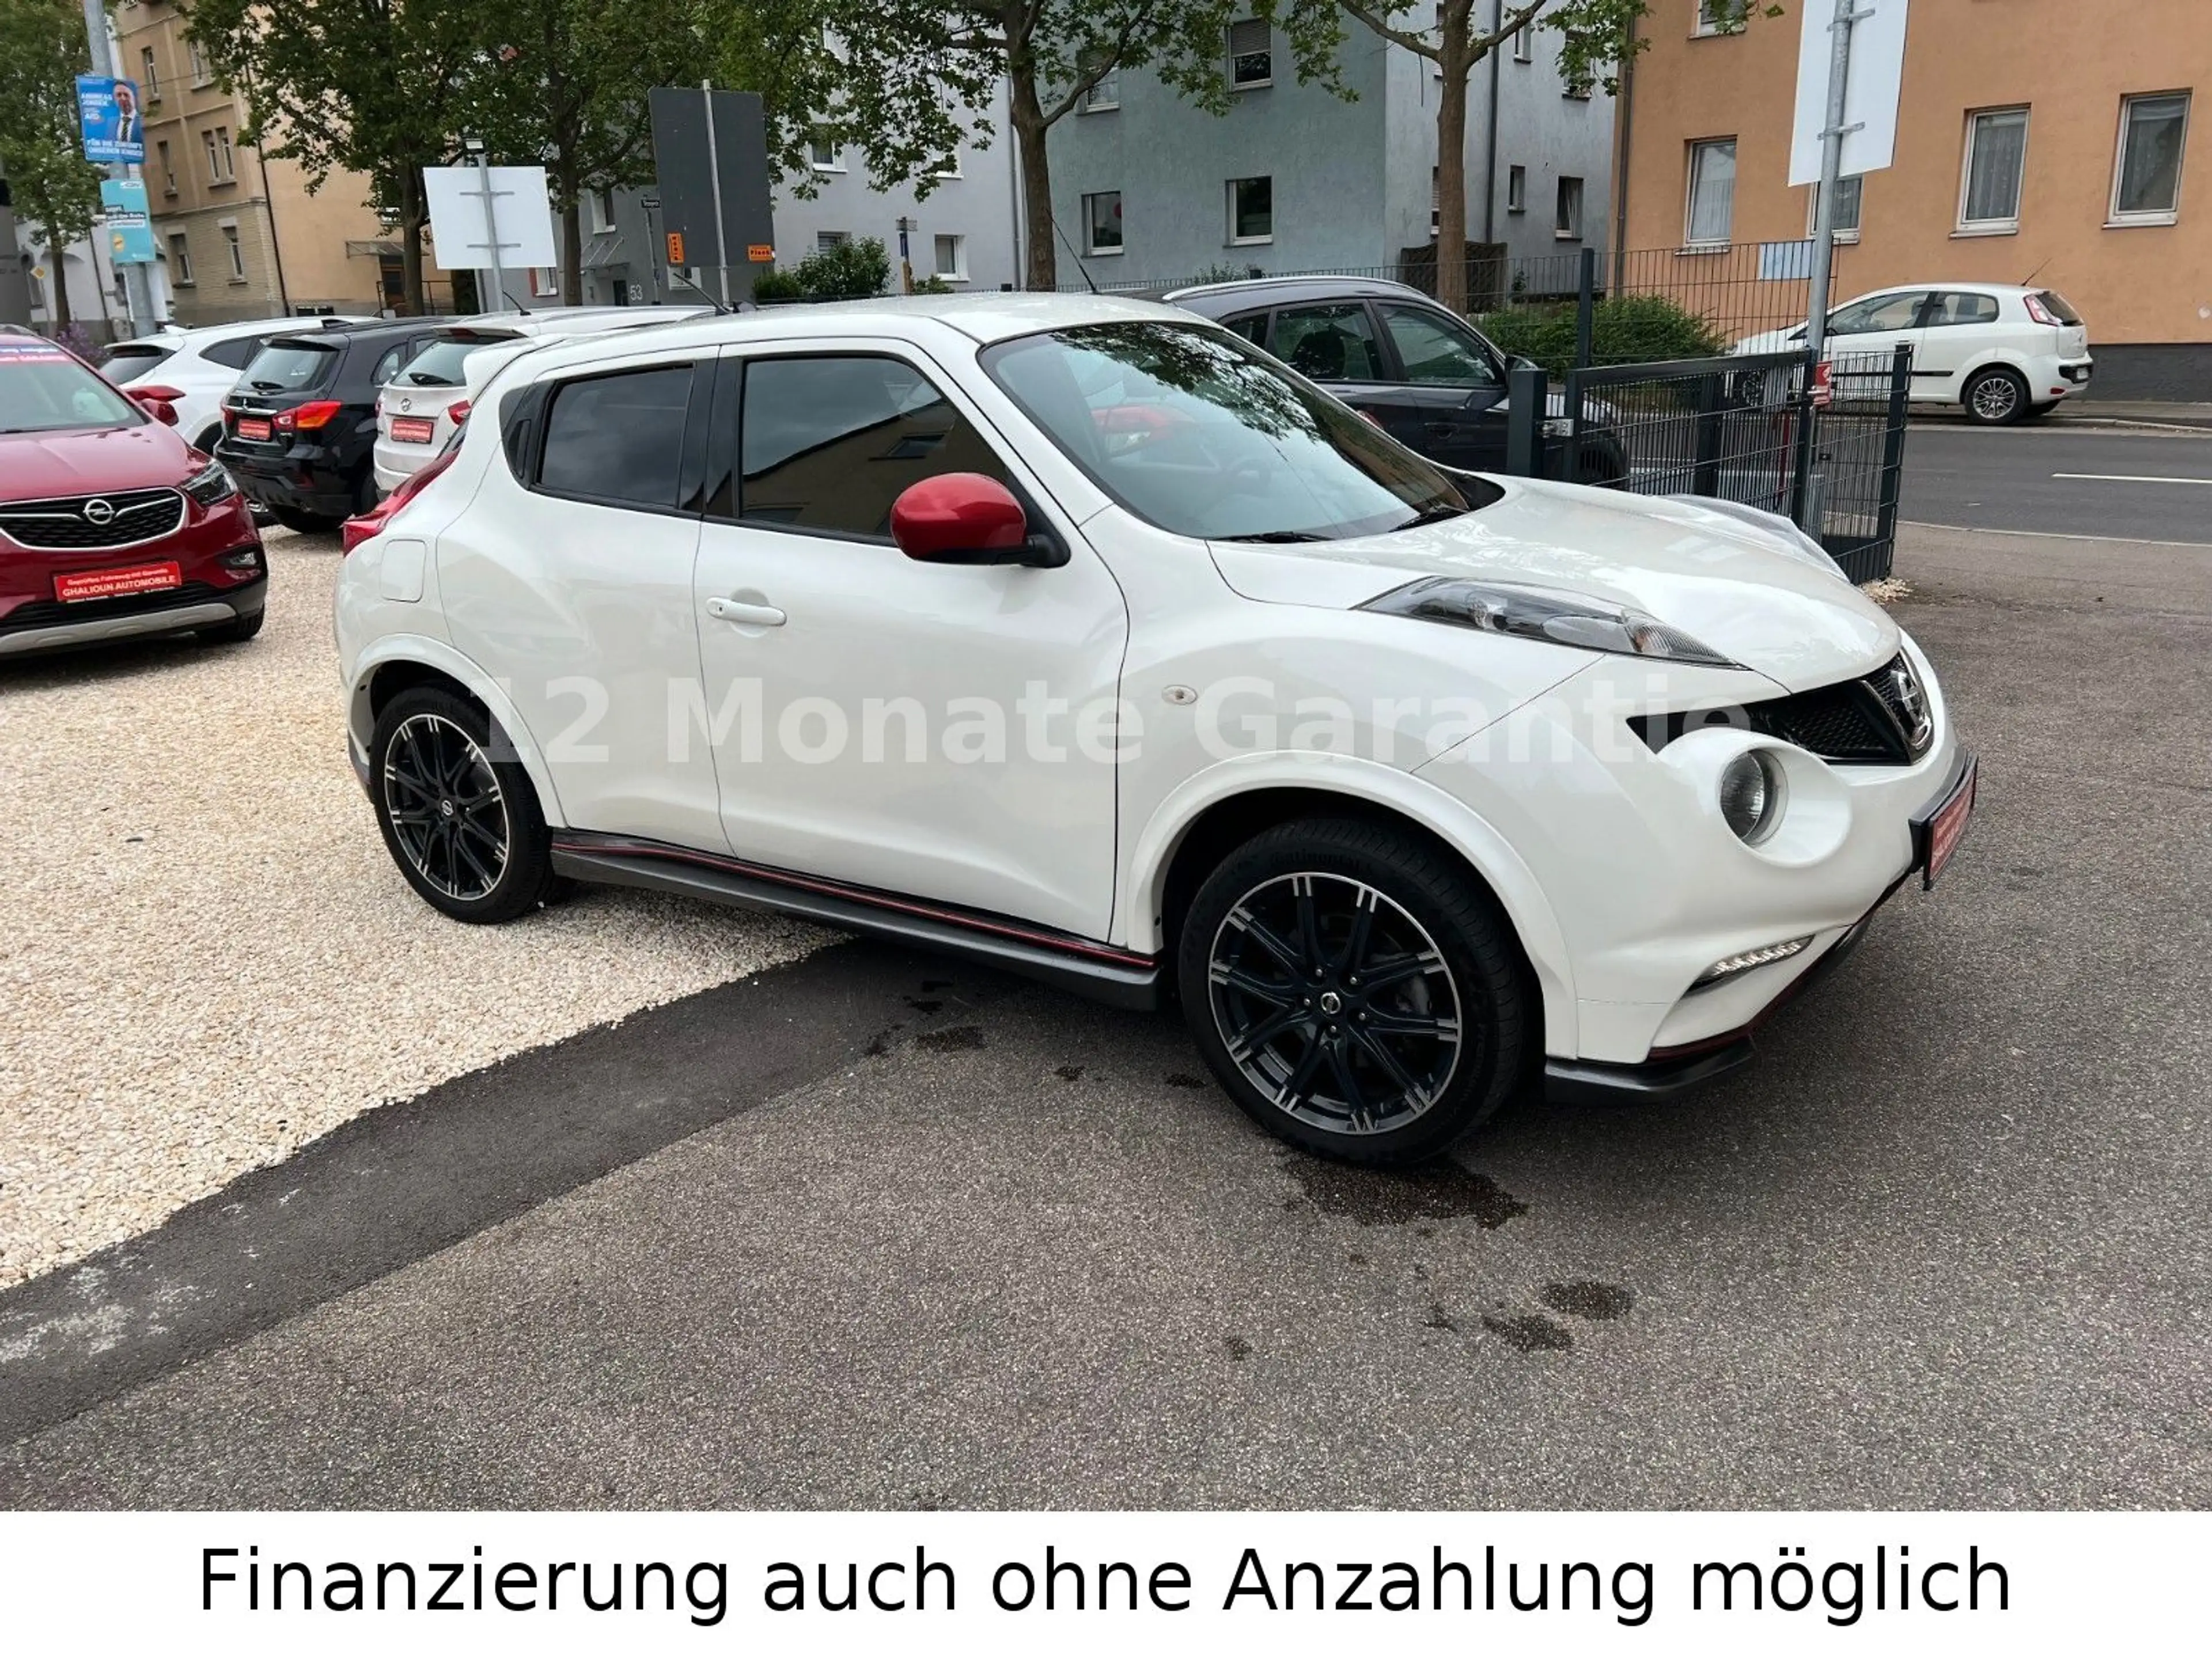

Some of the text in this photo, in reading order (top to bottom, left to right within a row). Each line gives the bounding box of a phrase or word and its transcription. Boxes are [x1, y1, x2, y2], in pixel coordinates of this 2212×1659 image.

[630, 285, 643, 301] 53
[62, 582, 113, 597] GHALIOUN
[115, 575, 175, 590] AUTOMOBILE
